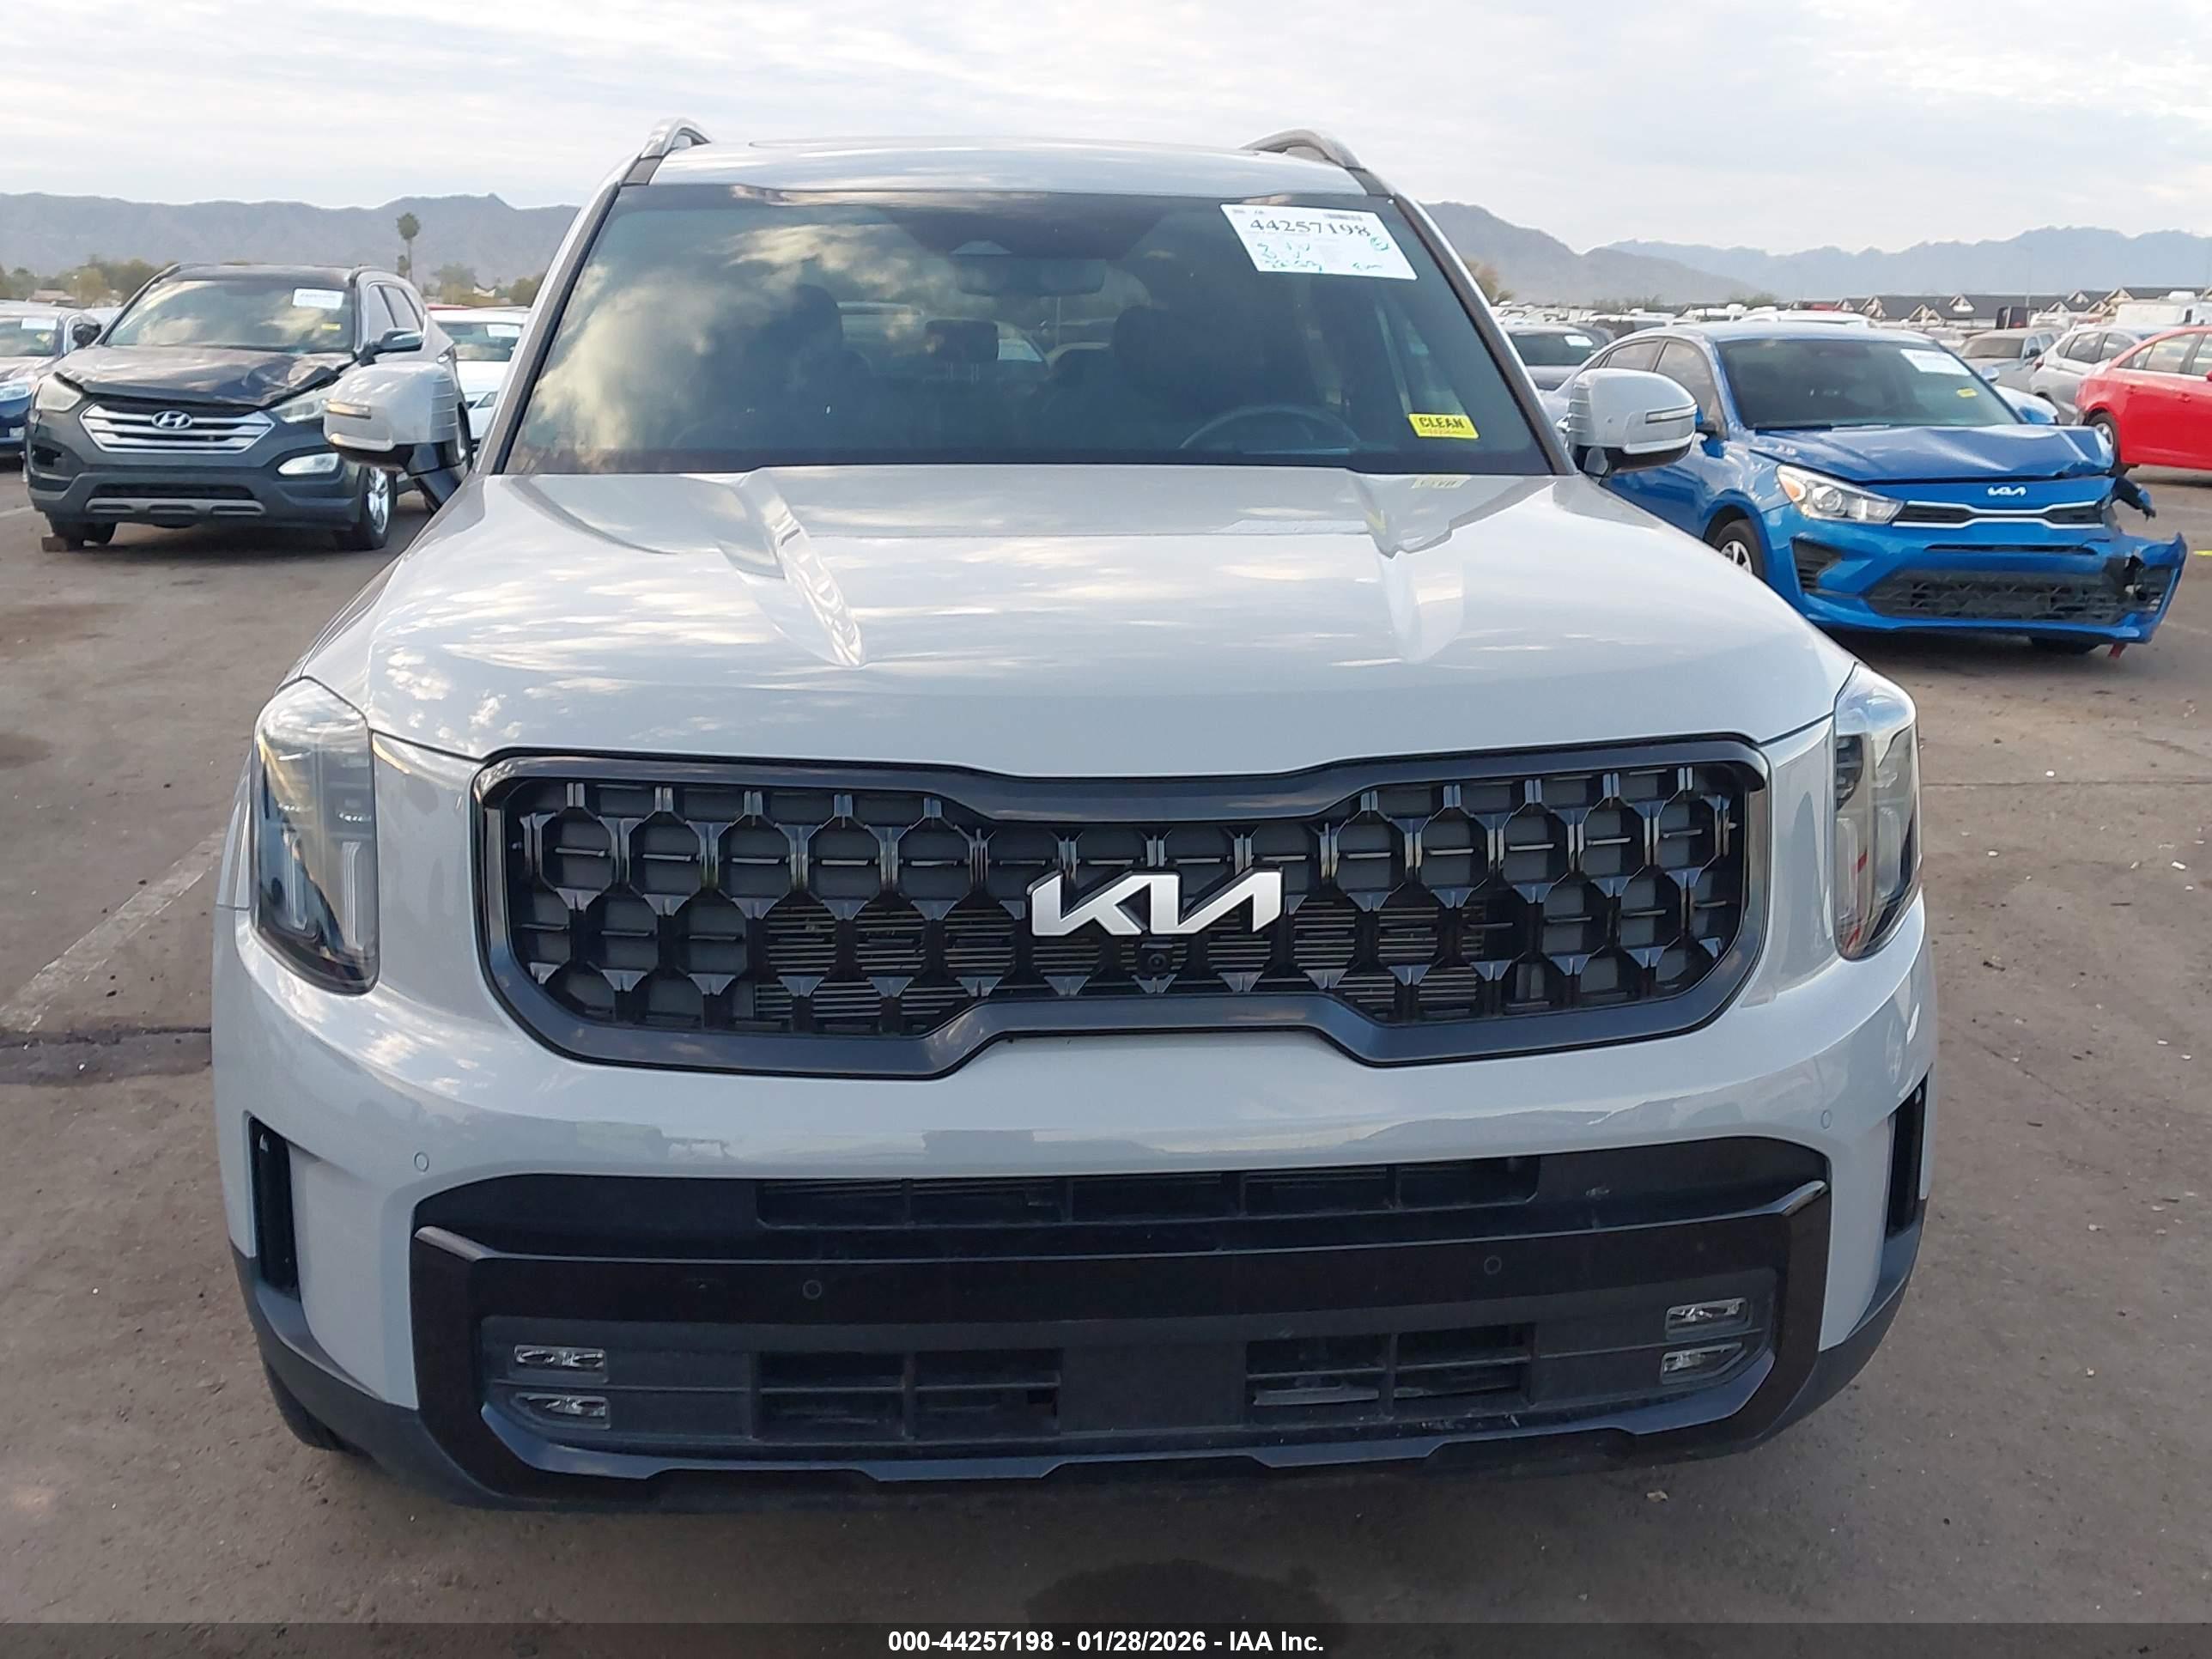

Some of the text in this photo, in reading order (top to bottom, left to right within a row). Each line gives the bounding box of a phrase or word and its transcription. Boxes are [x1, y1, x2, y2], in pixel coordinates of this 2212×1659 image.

[1250, 219, 1372, 237] 44257198
[1419, 416, 1465, 428] CLEAN
[1030, 868, 1284, 936] KIA
